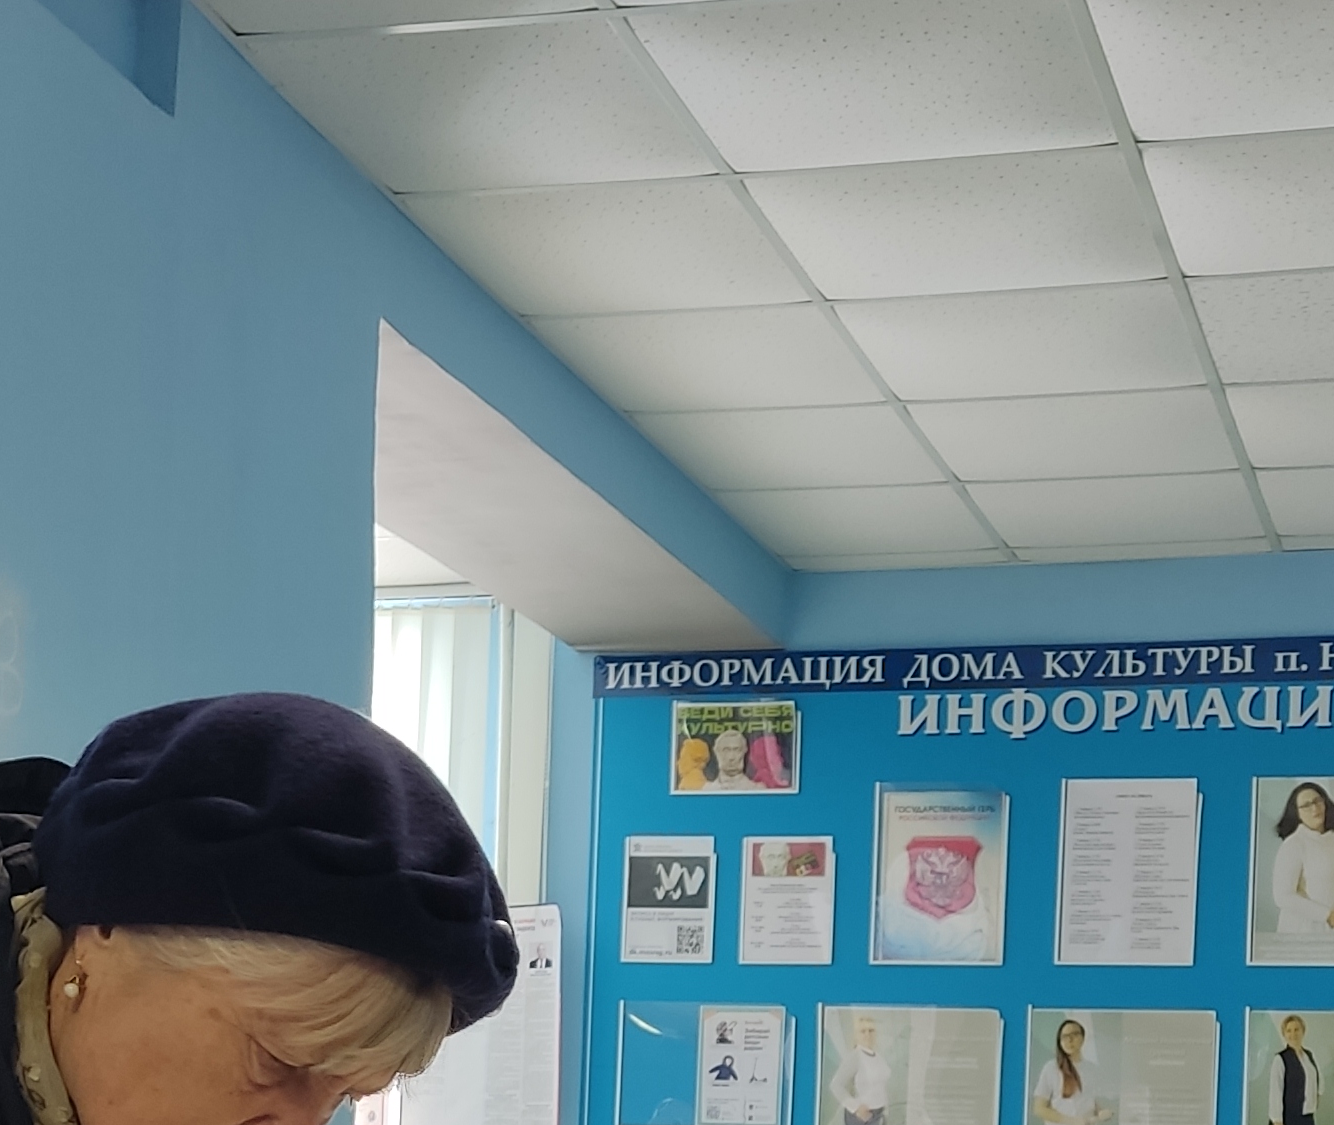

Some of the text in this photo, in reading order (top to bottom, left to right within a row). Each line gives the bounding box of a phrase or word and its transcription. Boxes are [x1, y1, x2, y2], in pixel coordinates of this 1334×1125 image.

[605, 654, 885, 691] ИНФОРМАЦИЯ
[902, 650, 1024, 688] ДОМА
[1042, 644, 1256, 680] КУЛЬТУРЫ
[1273, 651, 1309, 673] п.
[679, 705, 794, 720] ВЕДИ СЕБЯ
[677, 720, 794, 735] КУЛЬТУРНО
